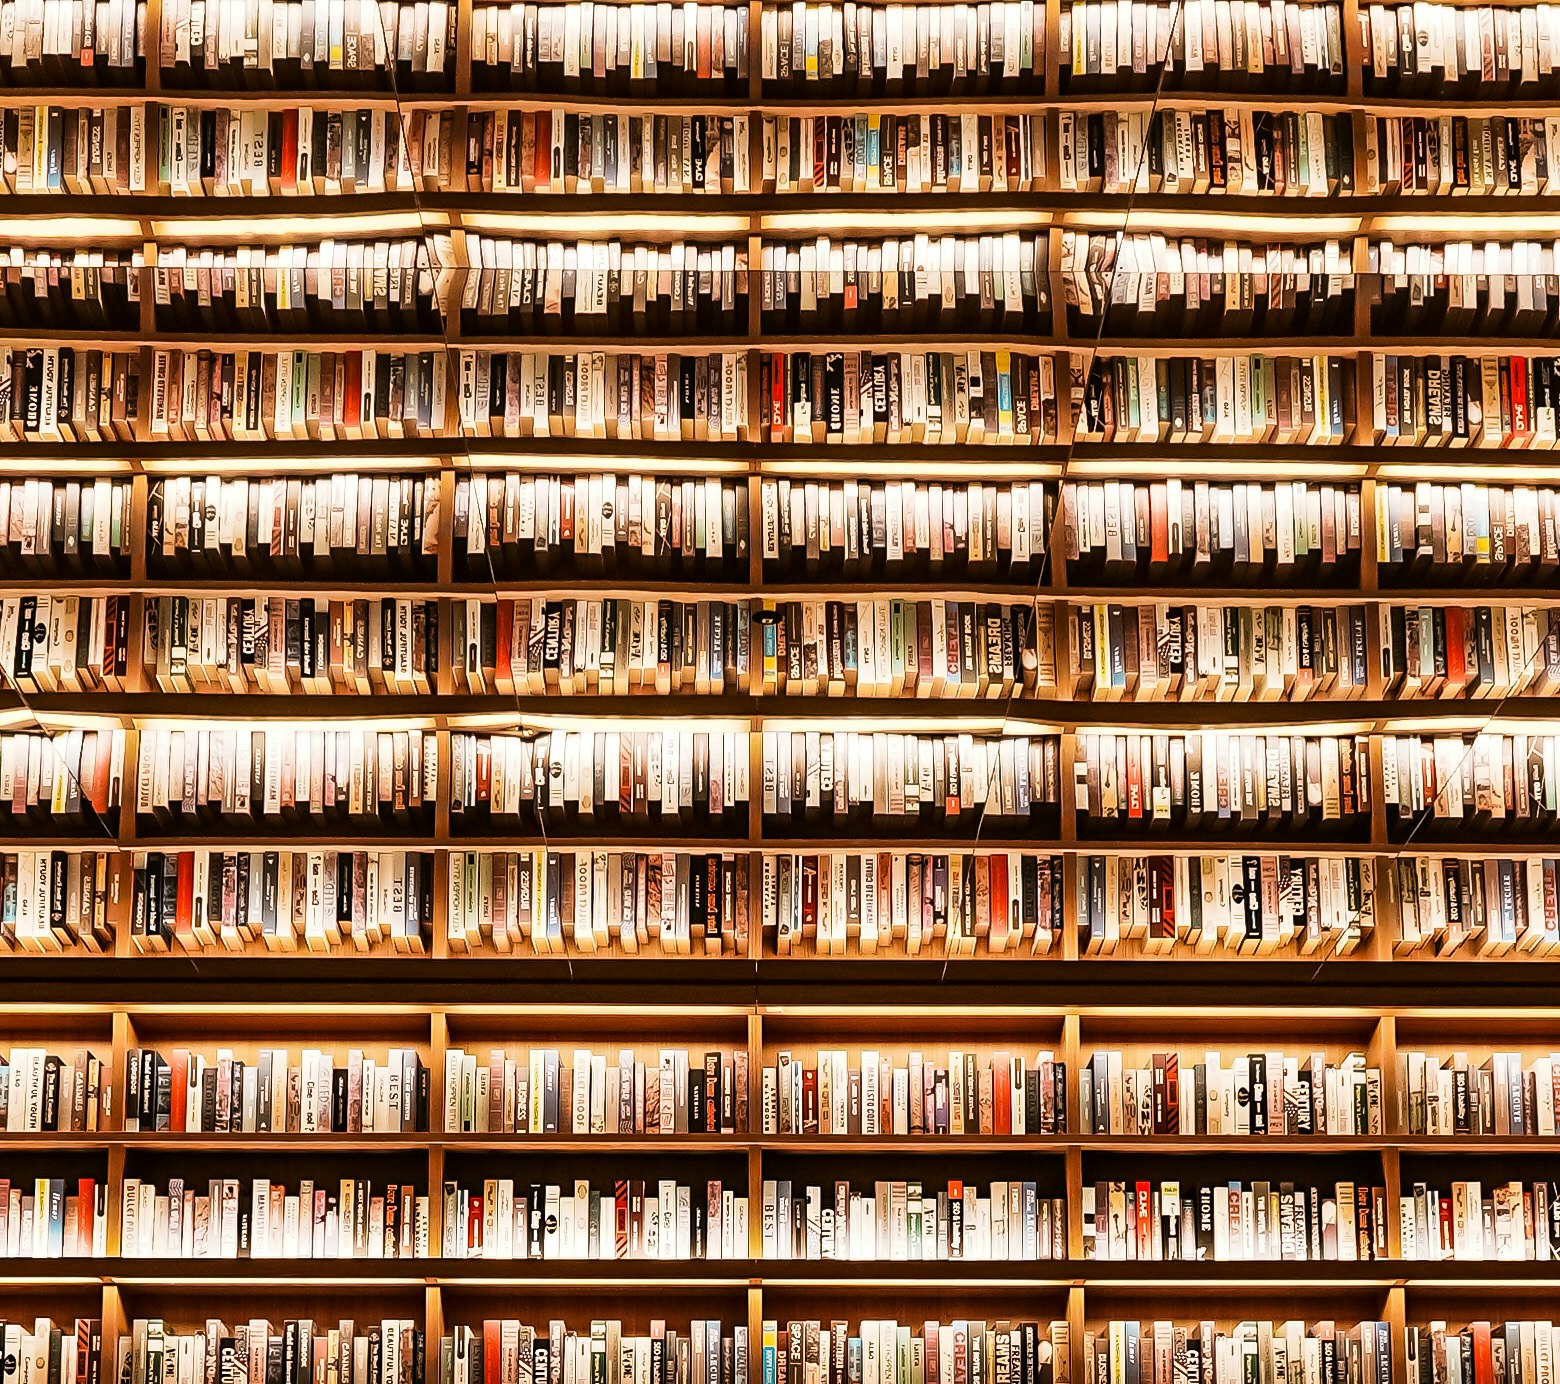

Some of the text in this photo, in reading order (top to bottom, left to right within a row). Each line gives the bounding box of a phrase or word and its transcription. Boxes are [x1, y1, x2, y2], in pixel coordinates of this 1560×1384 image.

[390, 1074, 398, 1110] BEST
[1297, 1082, 1310, 1130] CENTURY
[1202, 1195, 1210, 1231] HOME
[791, 1324, 801, 1360] SPACE
